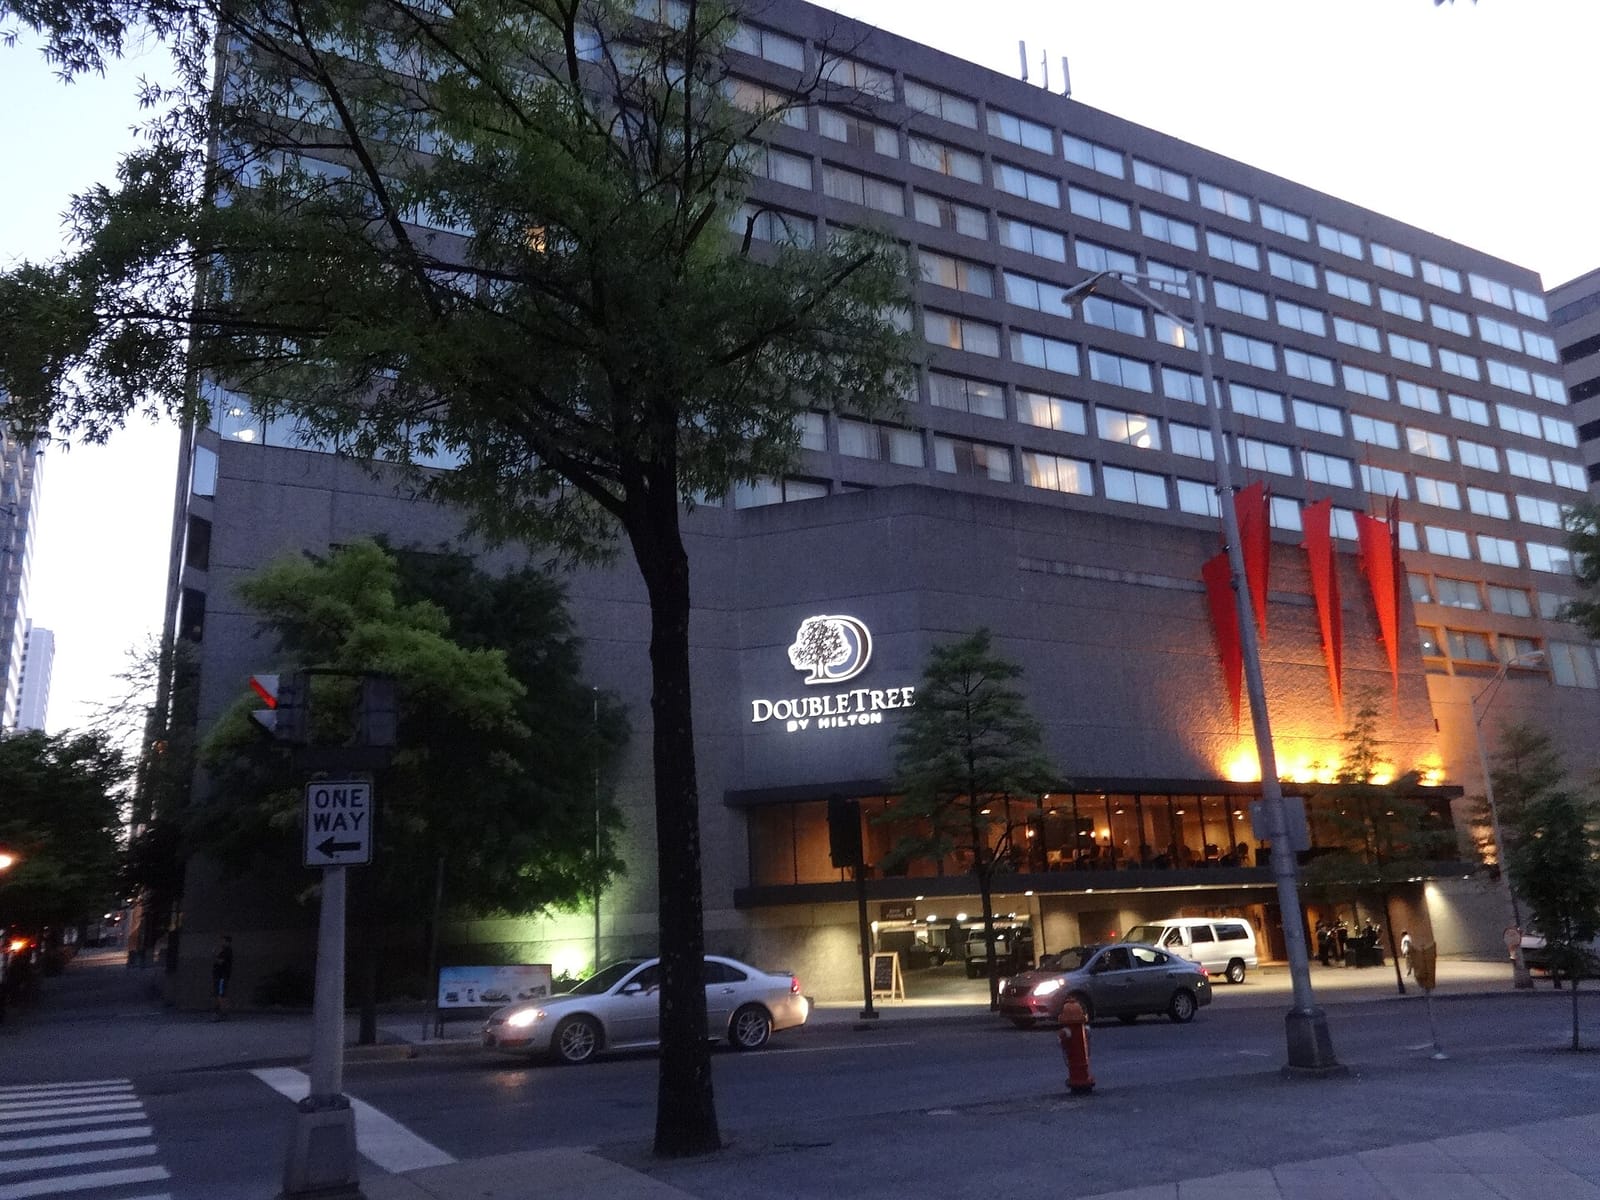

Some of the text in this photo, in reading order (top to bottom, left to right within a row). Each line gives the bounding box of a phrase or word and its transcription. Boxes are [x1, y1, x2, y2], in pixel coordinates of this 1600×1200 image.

[752, 686, 916, 723] DOUBLETREE
[787, 712, 882, 733] BY HILTON
[315, 788, 364, 809] ONE
[313, 811, 365, 833] WAY
